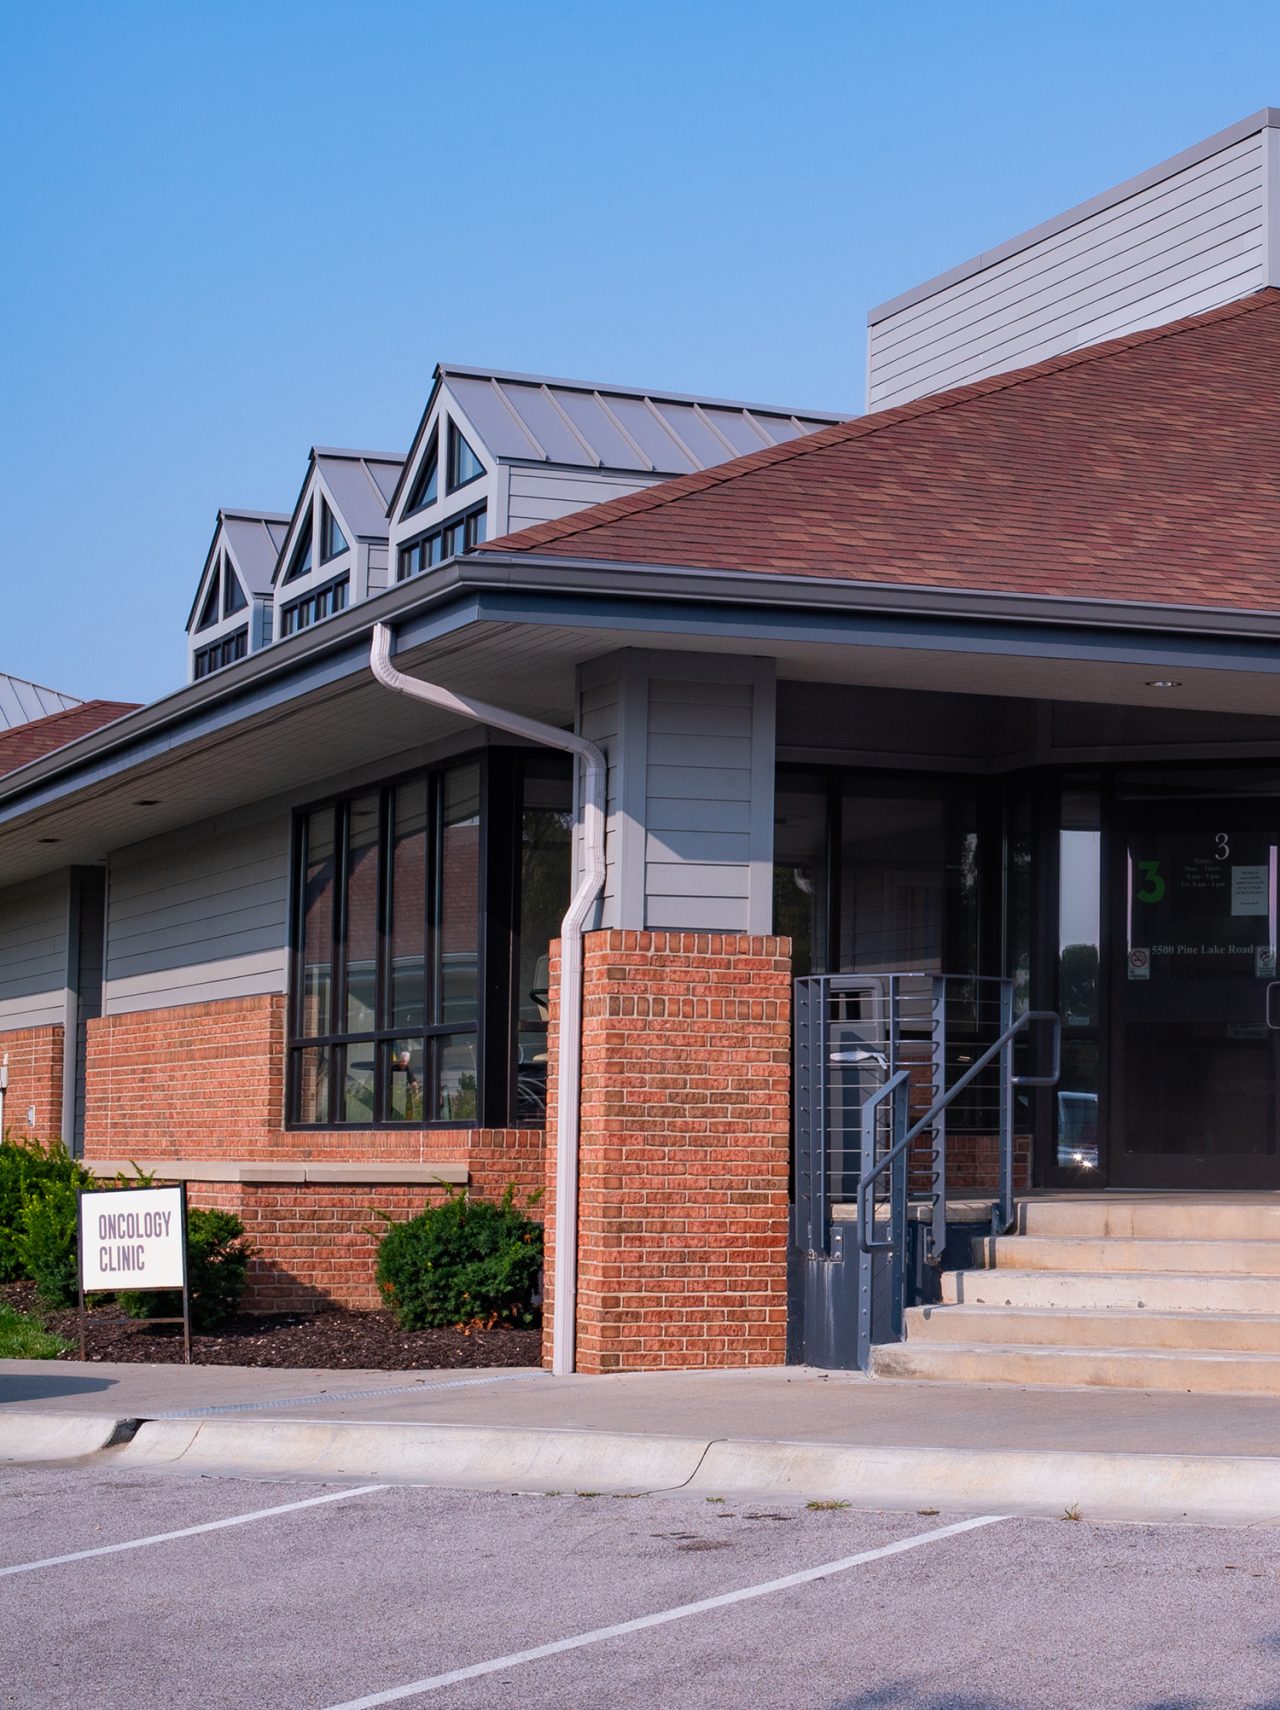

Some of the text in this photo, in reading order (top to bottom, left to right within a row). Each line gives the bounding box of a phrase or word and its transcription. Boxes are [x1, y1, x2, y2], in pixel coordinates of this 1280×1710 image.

[1215, 832, 1230, 860] 3
[1136, 860, 1166, 904] 3
[1151, 944, 1254, 955] 5500 Pine Lake Road
[98, 1211, 171, 1240] ONCOLOGY
[100, 1244, 145, 1272] CLINIC
